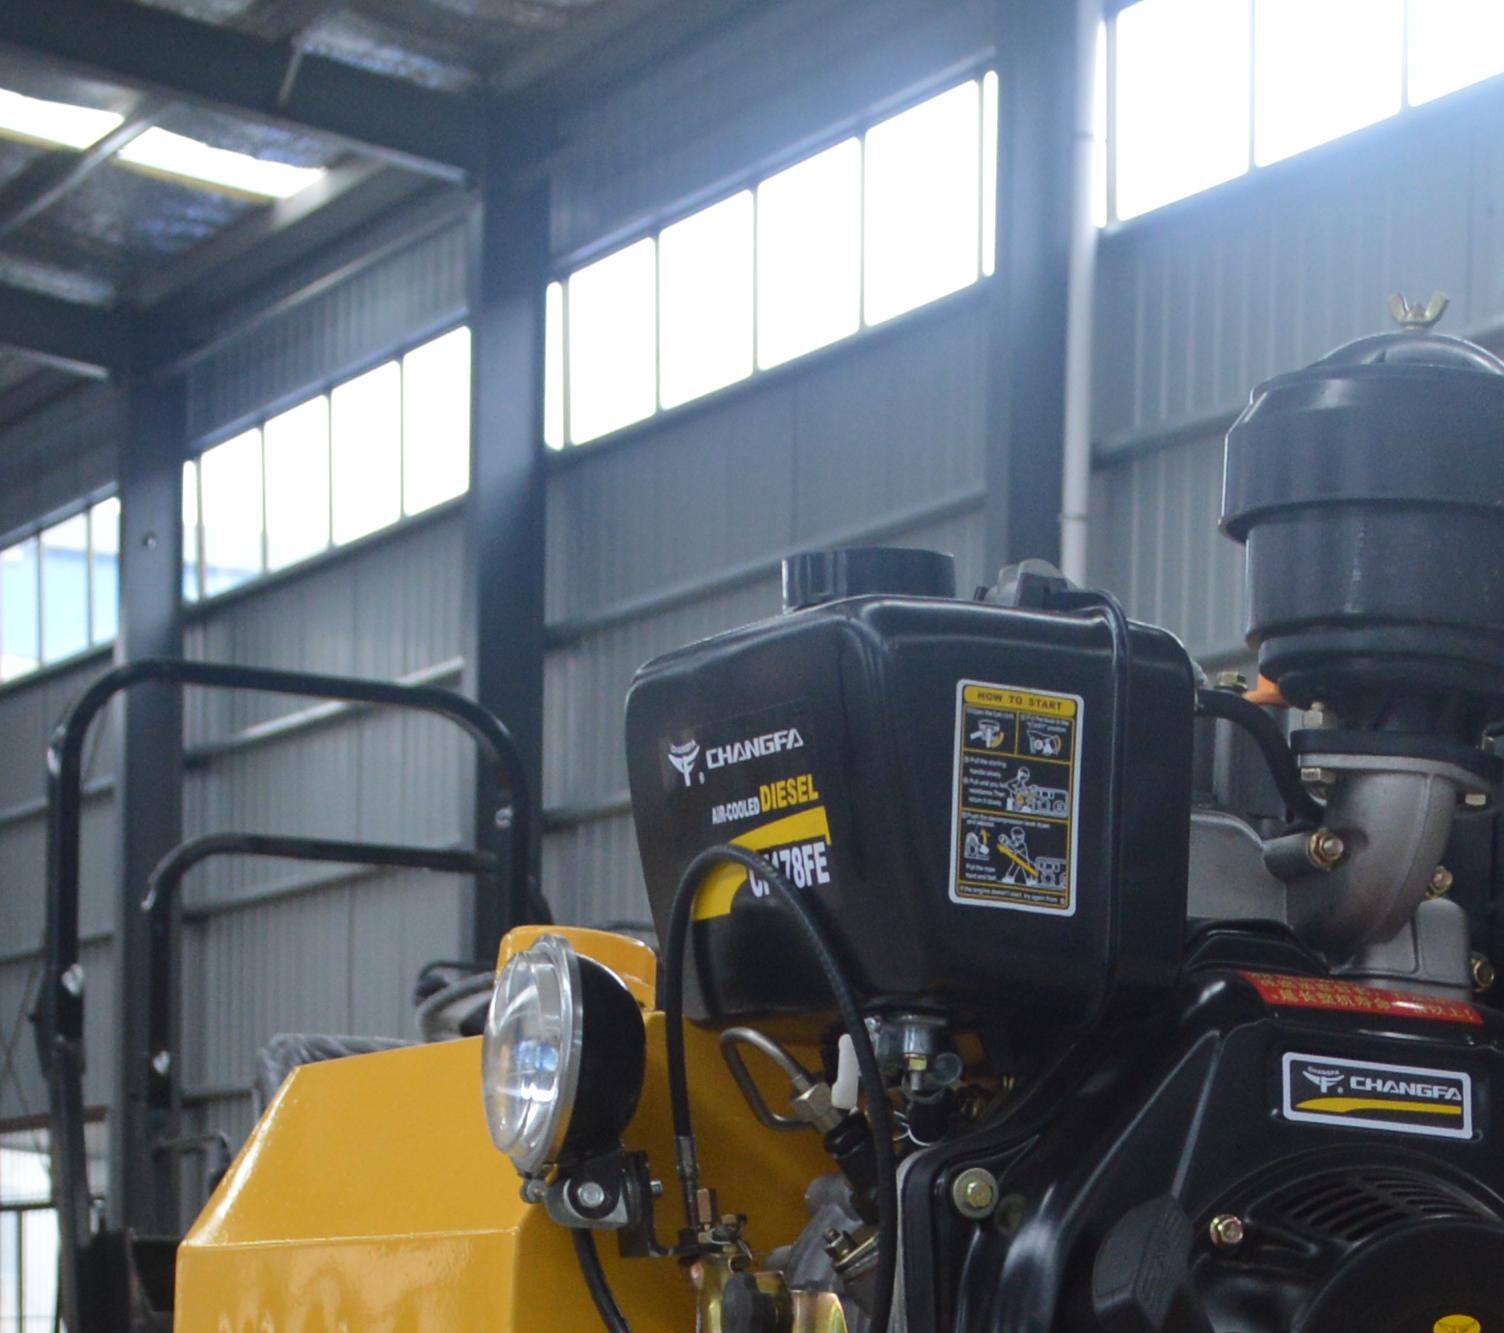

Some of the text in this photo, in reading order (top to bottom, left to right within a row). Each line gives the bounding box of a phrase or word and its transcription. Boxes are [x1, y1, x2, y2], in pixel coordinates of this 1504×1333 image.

[977, 691, 1063, 711] HOW TO START
[705, 728, 804, 770] CHANGFA
[760, 774, 820, 812] DIESEL
[1350, 1076, 1462, 1100] CHANGFA
